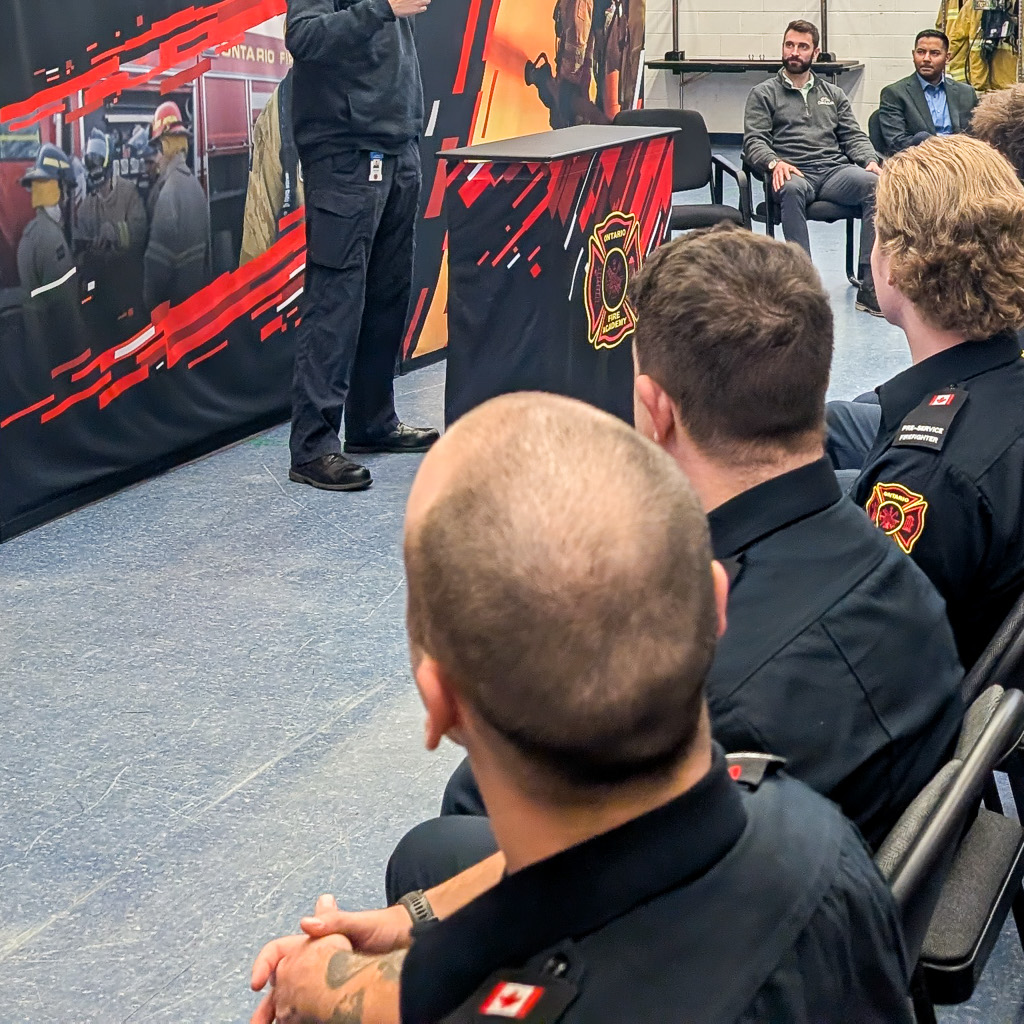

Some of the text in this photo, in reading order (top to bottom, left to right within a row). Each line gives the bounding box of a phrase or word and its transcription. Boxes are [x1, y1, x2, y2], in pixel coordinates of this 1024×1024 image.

[603, 228, 626, 242] ONTARIO
[607, 310, 621, 322] FIRE
[602, 316, 627, 334] ACADEMY
[901, 424, 944, 434] PRE-SERVICE
[899, 433, 939, 444] FIREFIGHTER
